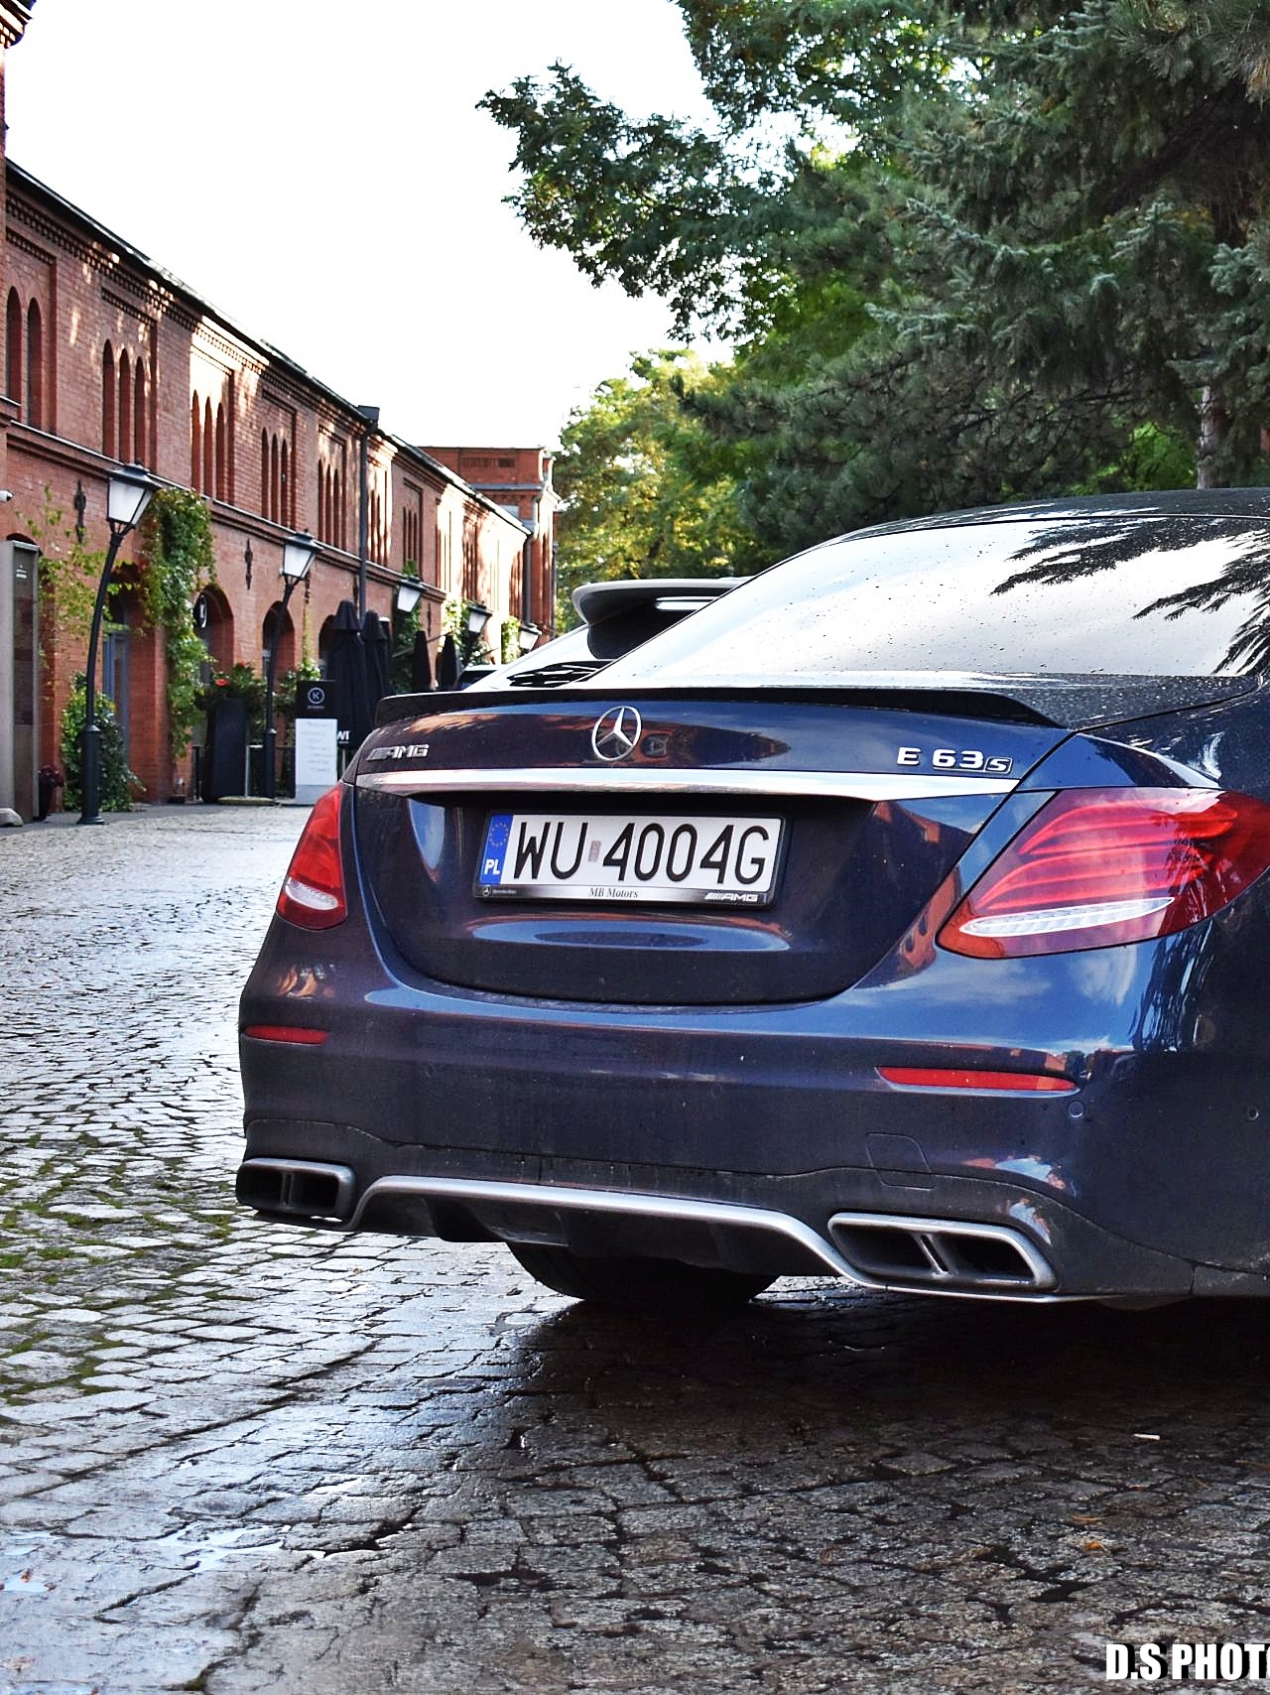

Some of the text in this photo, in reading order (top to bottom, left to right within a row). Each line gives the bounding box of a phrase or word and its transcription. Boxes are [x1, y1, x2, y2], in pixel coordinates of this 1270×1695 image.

[897, 746, 921, 765] E
[484, 821, 770, 885] PL WU 4004G
[588, 887, 639, 898] MB Motors
[720, 892, 759, 902] AMG
